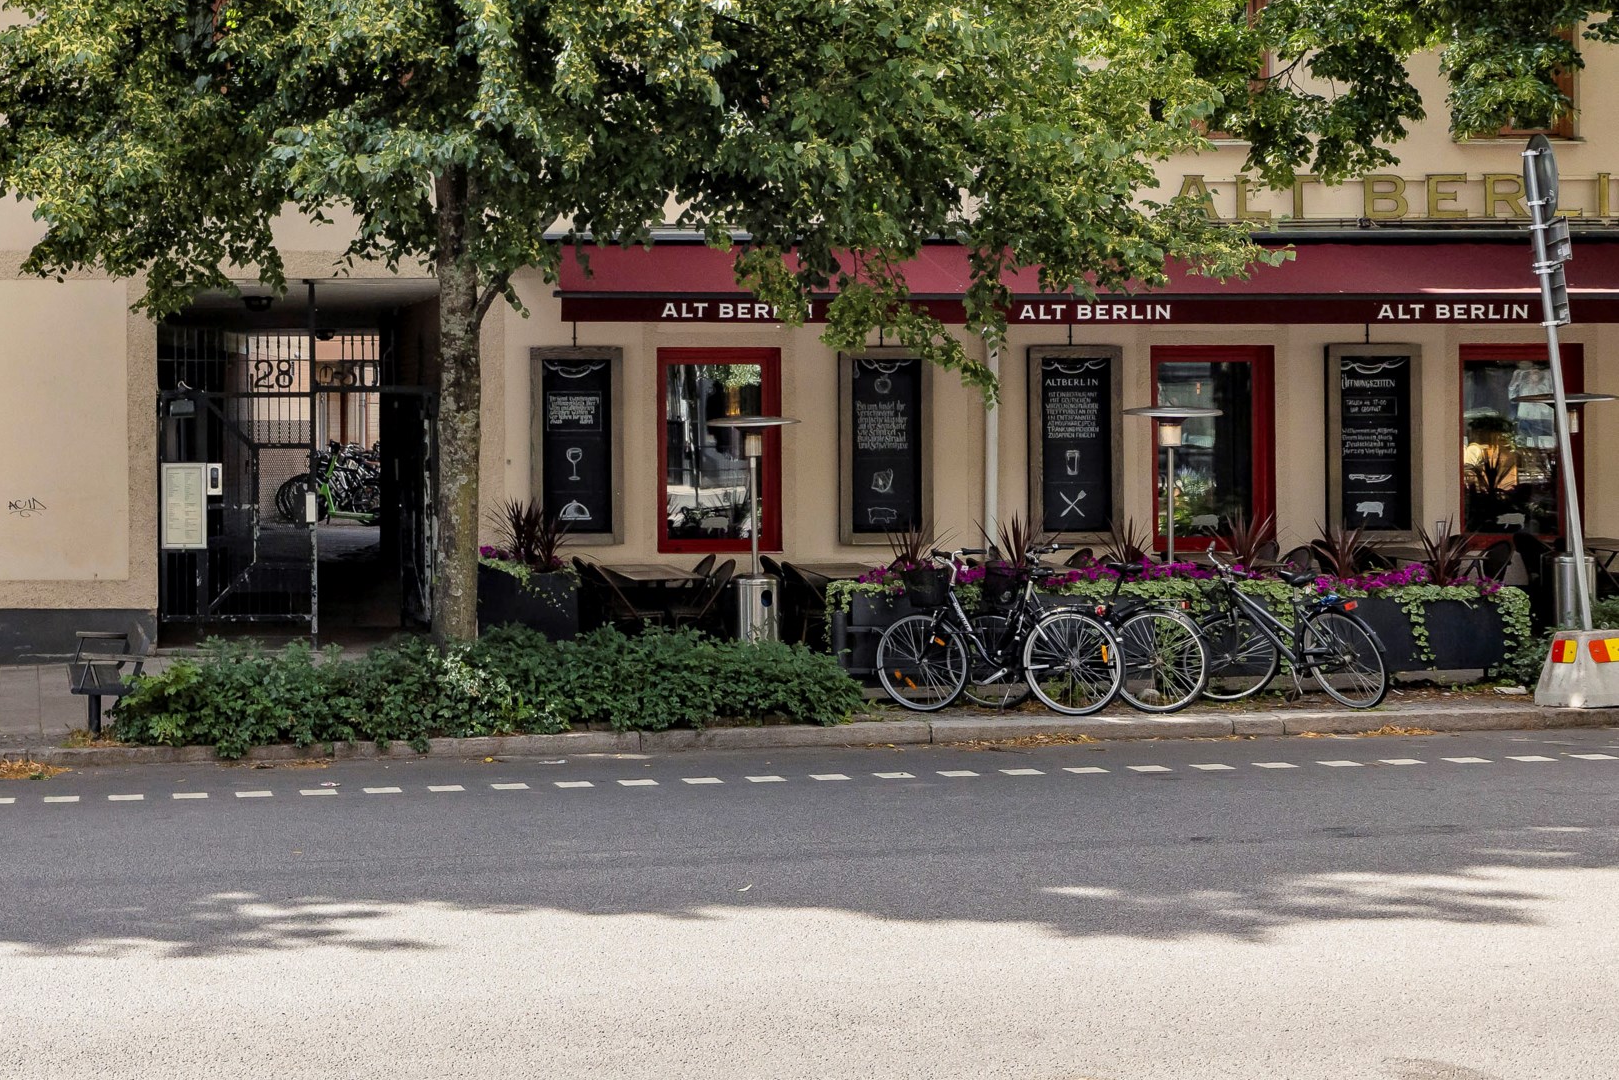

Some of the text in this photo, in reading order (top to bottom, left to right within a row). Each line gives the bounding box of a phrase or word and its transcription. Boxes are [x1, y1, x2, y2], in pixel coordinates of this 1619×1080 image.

[1178, 172, 1613, 220] ALT BERI
[662, 302, 813, 319] ALT BER
[1019, 304, 1171, 320] ALT BERLIN
[1377, 304, 1528, 319] ALT BERLIN
[254, 360, 293, 388] 28
